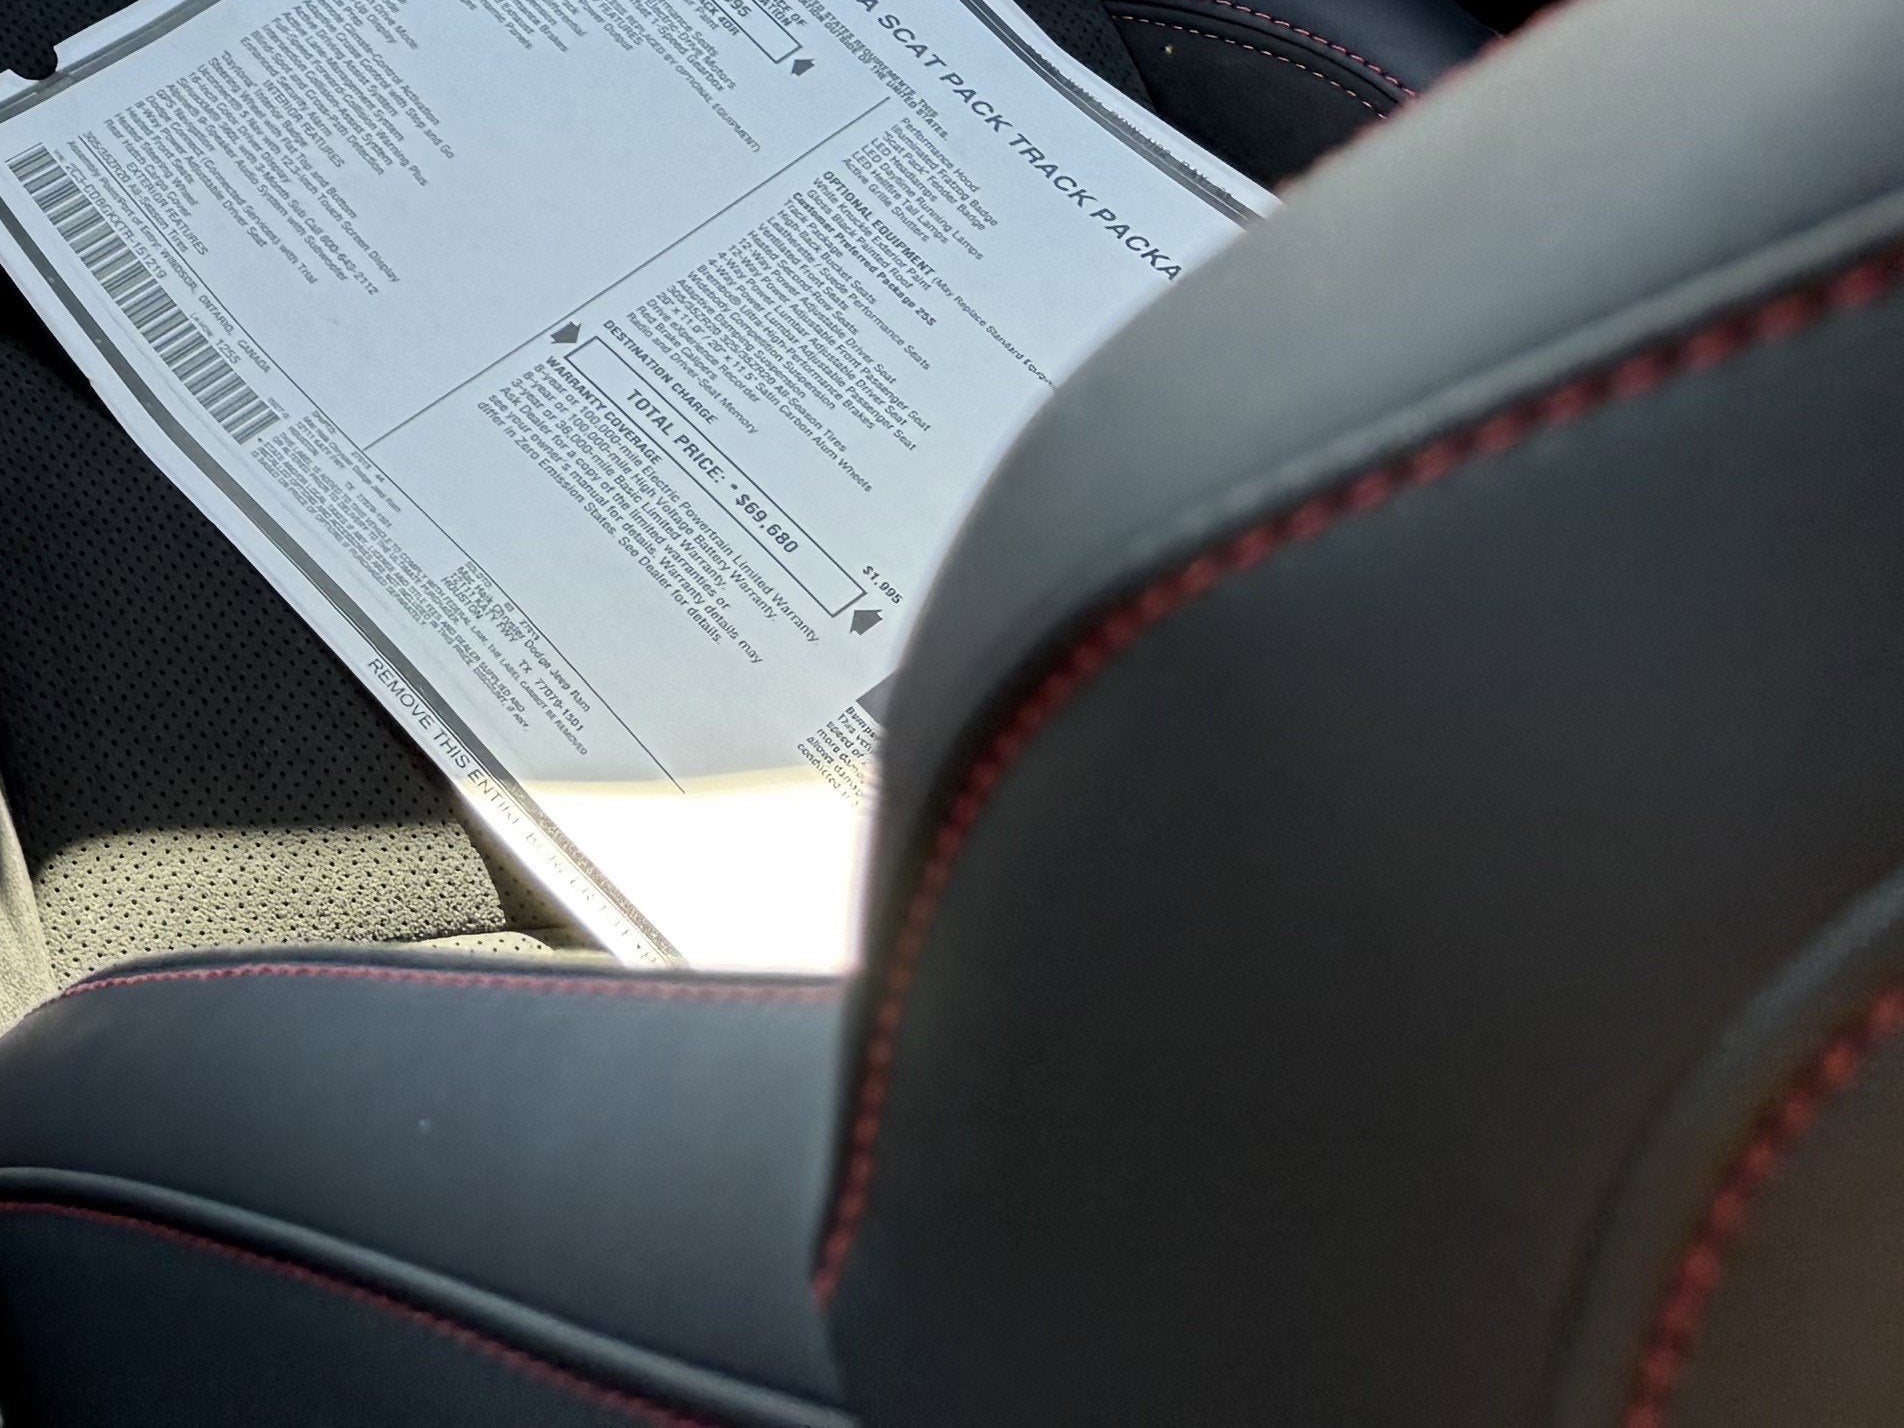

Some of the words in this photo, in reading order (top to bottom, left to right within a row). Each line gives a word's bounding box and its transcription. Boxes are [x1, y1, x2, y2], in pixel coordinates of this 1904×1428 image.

[877, 14, 946, 66] SCAT
[939, 72, 1012, 132] PACK
[1009, 133, 1096, 207] TRACK
[1090, 208, 1181, 280] PACKA
[822, 170, 872, 221] OPTIONAL
[871, 219, 935, 275] EQUIPMENT
[499, 386, 522, 407] Ask
[545, 355, 607, 410] WARRANTY
[603, 411, 661, 464] COVERAGE
[518, 403, 553, 434] Dealer
[550, 433, 570, 449] for
[574, 457, 602, 481] copy
[603, 319, 673, 383] DESTINATION
[670, 382, 717, 424] CHARGE
[862, 565, 902, 603] $1,995
[626, 388, 673, 435] TOTAL
[673, 434, 724, 483] PRICE:
[735, 493, 798, 552] $69,680
[599, 480, 614, 493] of
[606, 492, 630, 511] the
[628, 509, 666, 545] limited
[663, 543, 716, 597] warranties
[714, 596, 730, 609] or
[367, 658, 435, 730] REMOVE
[433, 727, 470, 769] THIS
